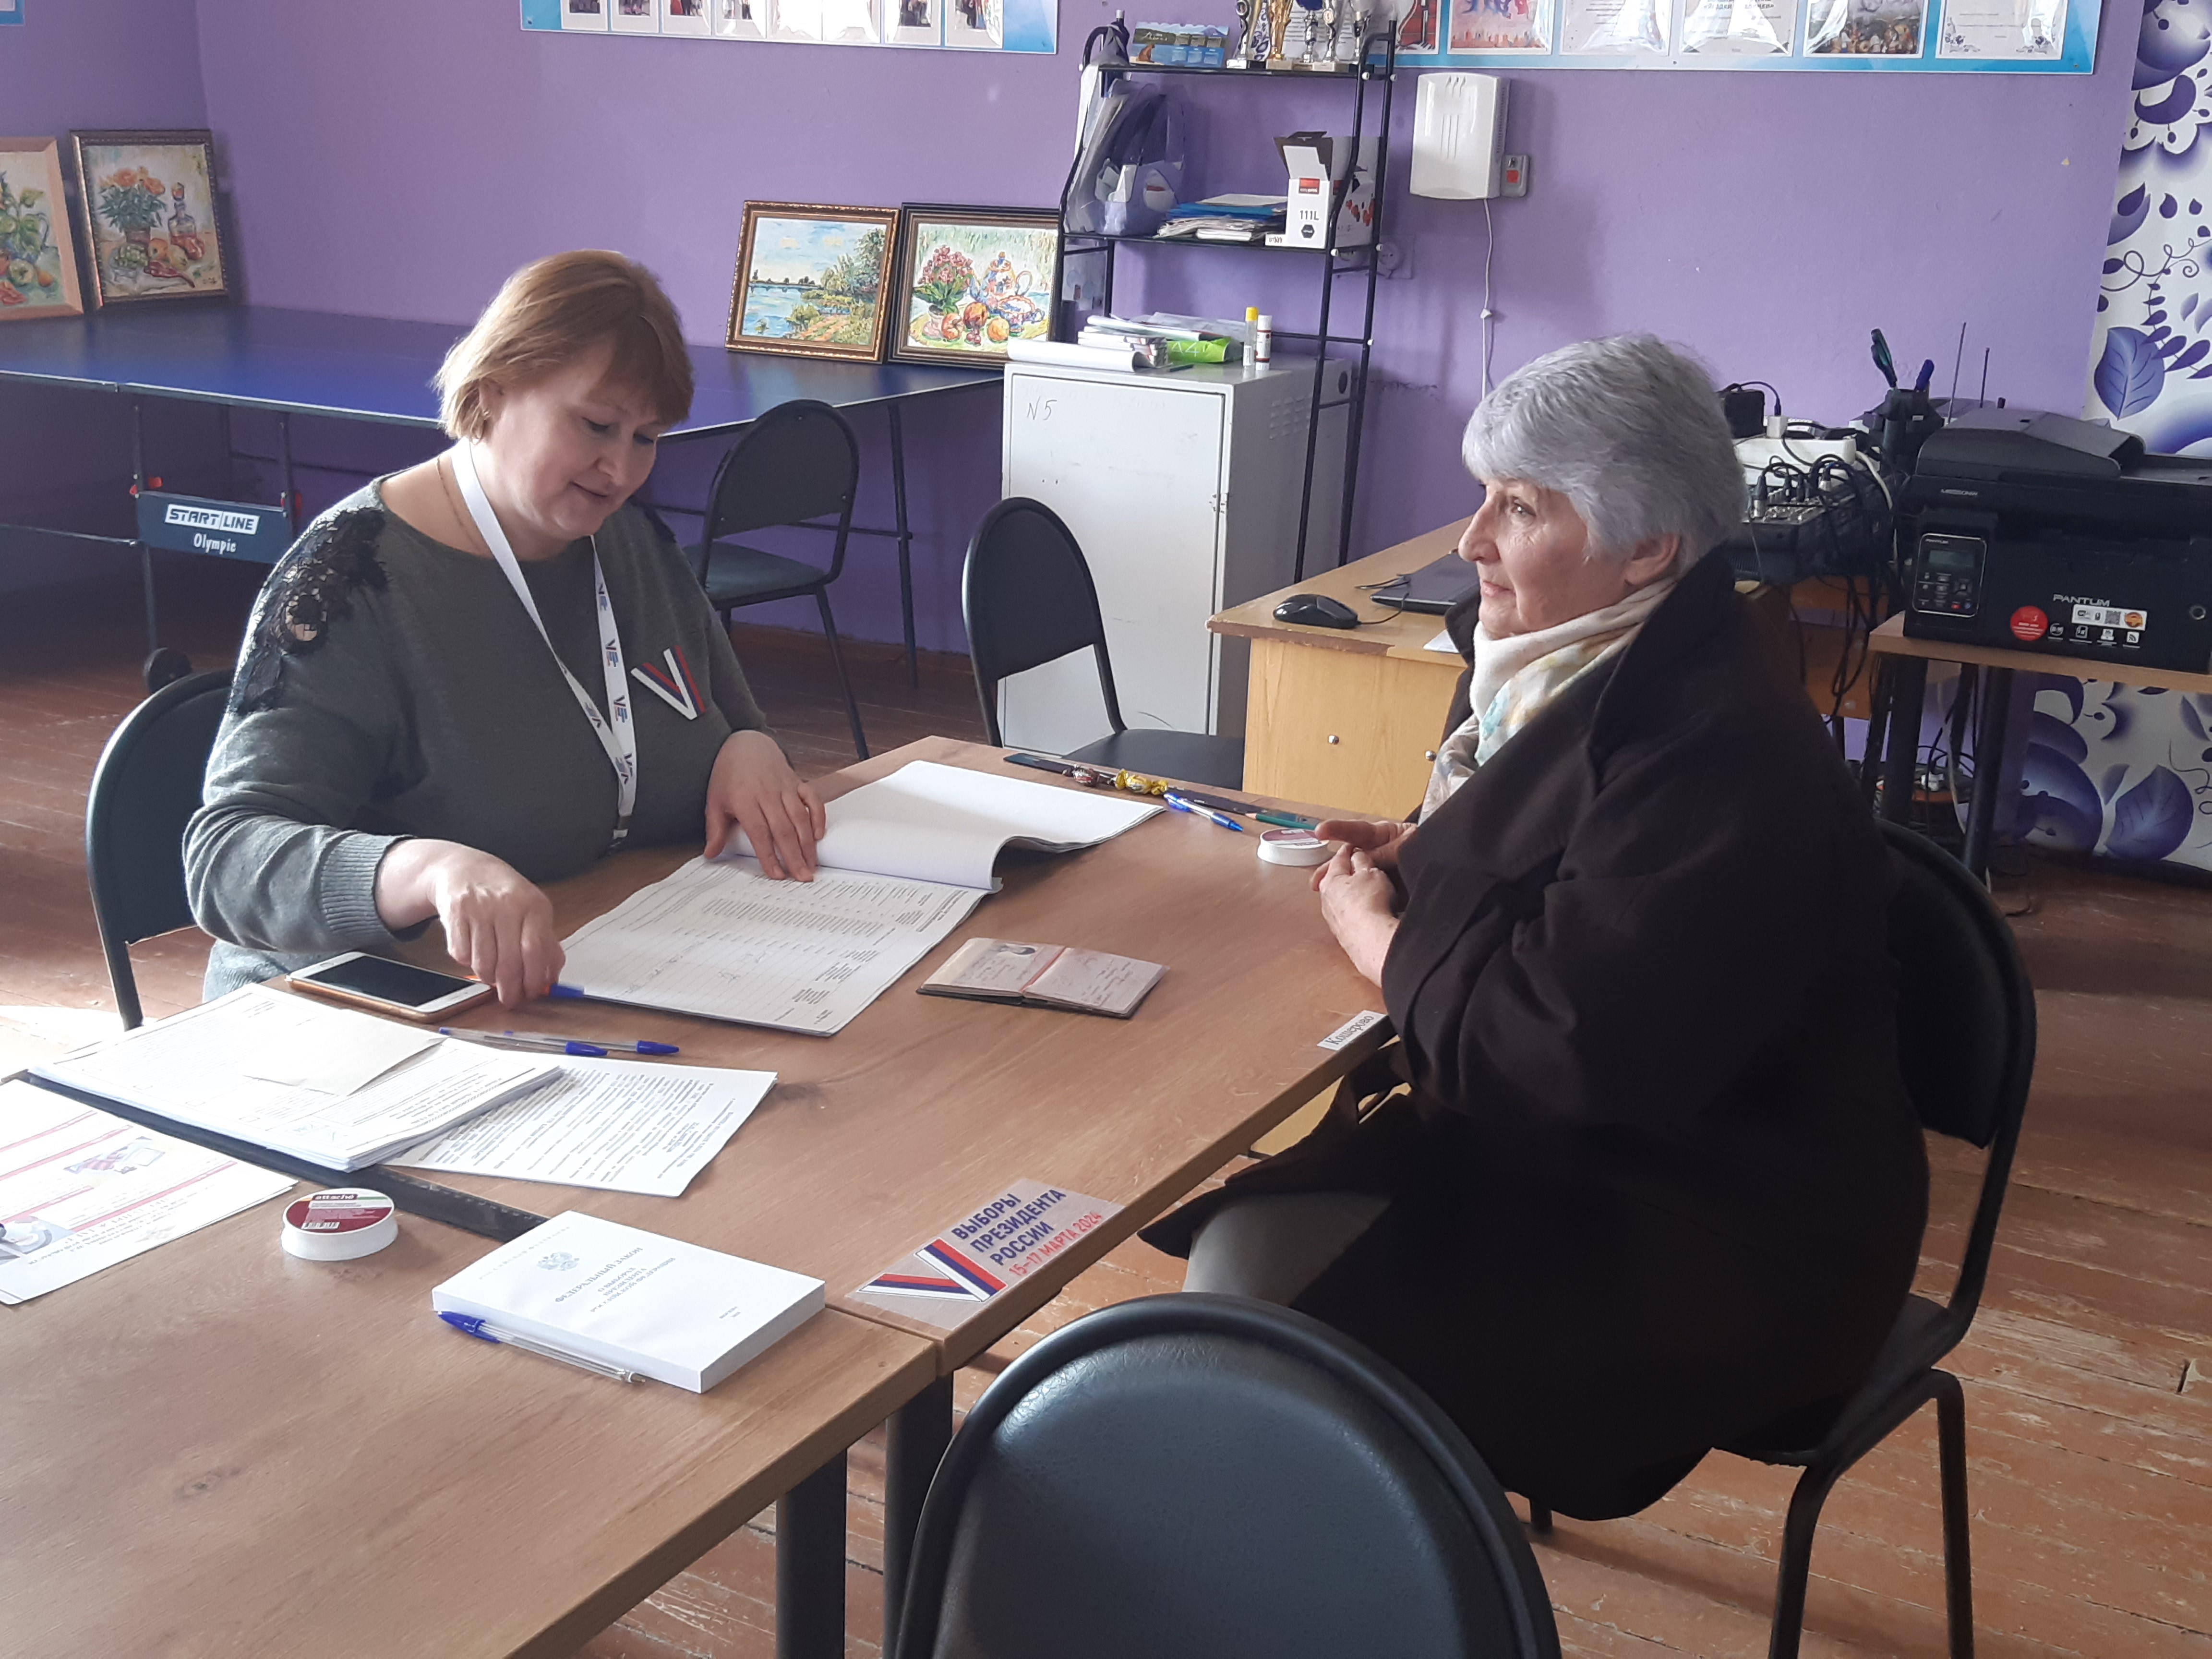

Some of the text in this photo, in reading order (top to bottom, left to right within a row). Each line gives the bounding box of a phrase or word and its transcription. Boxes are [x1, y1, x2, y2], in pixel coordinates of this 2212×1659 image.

[1299, 210, 1320, 221] 111L
[169, 508, 254, 531] START LINE
[193, 532, 237, 555] Olympic
[2053, 593, 2111, 607] PANTUM
[1324, 1015, 1375, 1045] Кошерово
[951, 1193, 1022, 1240] ВЫБОРЫ
[970, 1189, 1067, 1253] ПРЕЗИДЕНТА
[1038, 1228, 1079, 1257] МАРТА
[1072, 1211, 1103, 1233] 2024
[989, 1221, 1054, 1266] РОССИИ
[555, 1247, 643, 1302] ФЕДЕРАЛЬНЫЙ ЗАКОН
